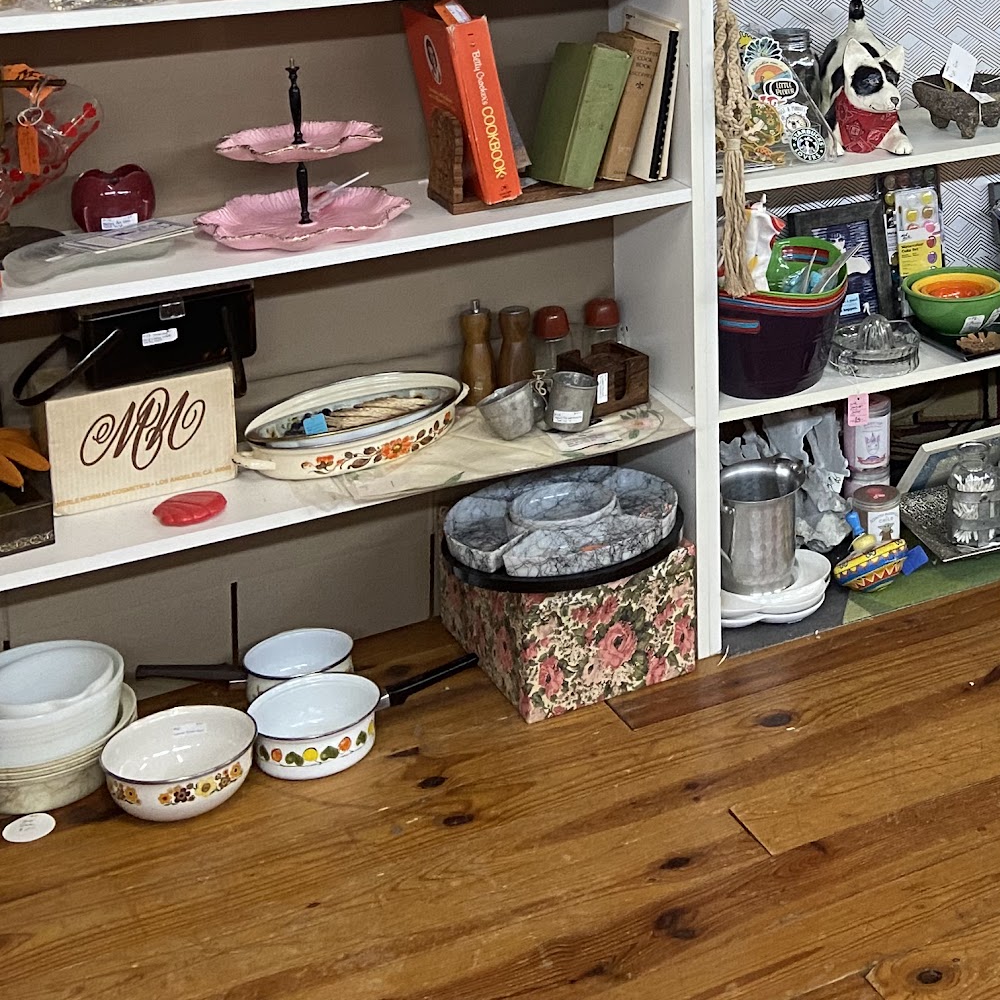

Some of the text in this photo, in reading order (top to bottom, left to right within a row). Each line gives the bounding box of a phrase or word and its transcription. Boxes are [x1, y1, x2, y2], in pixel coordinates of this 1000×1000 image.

[471, 50, 507, 180] Betty Crocker's COOKBOOK
[792, 129, 825, 147] STARBUCKS
[793, 149, 821, 161] LOVERS
